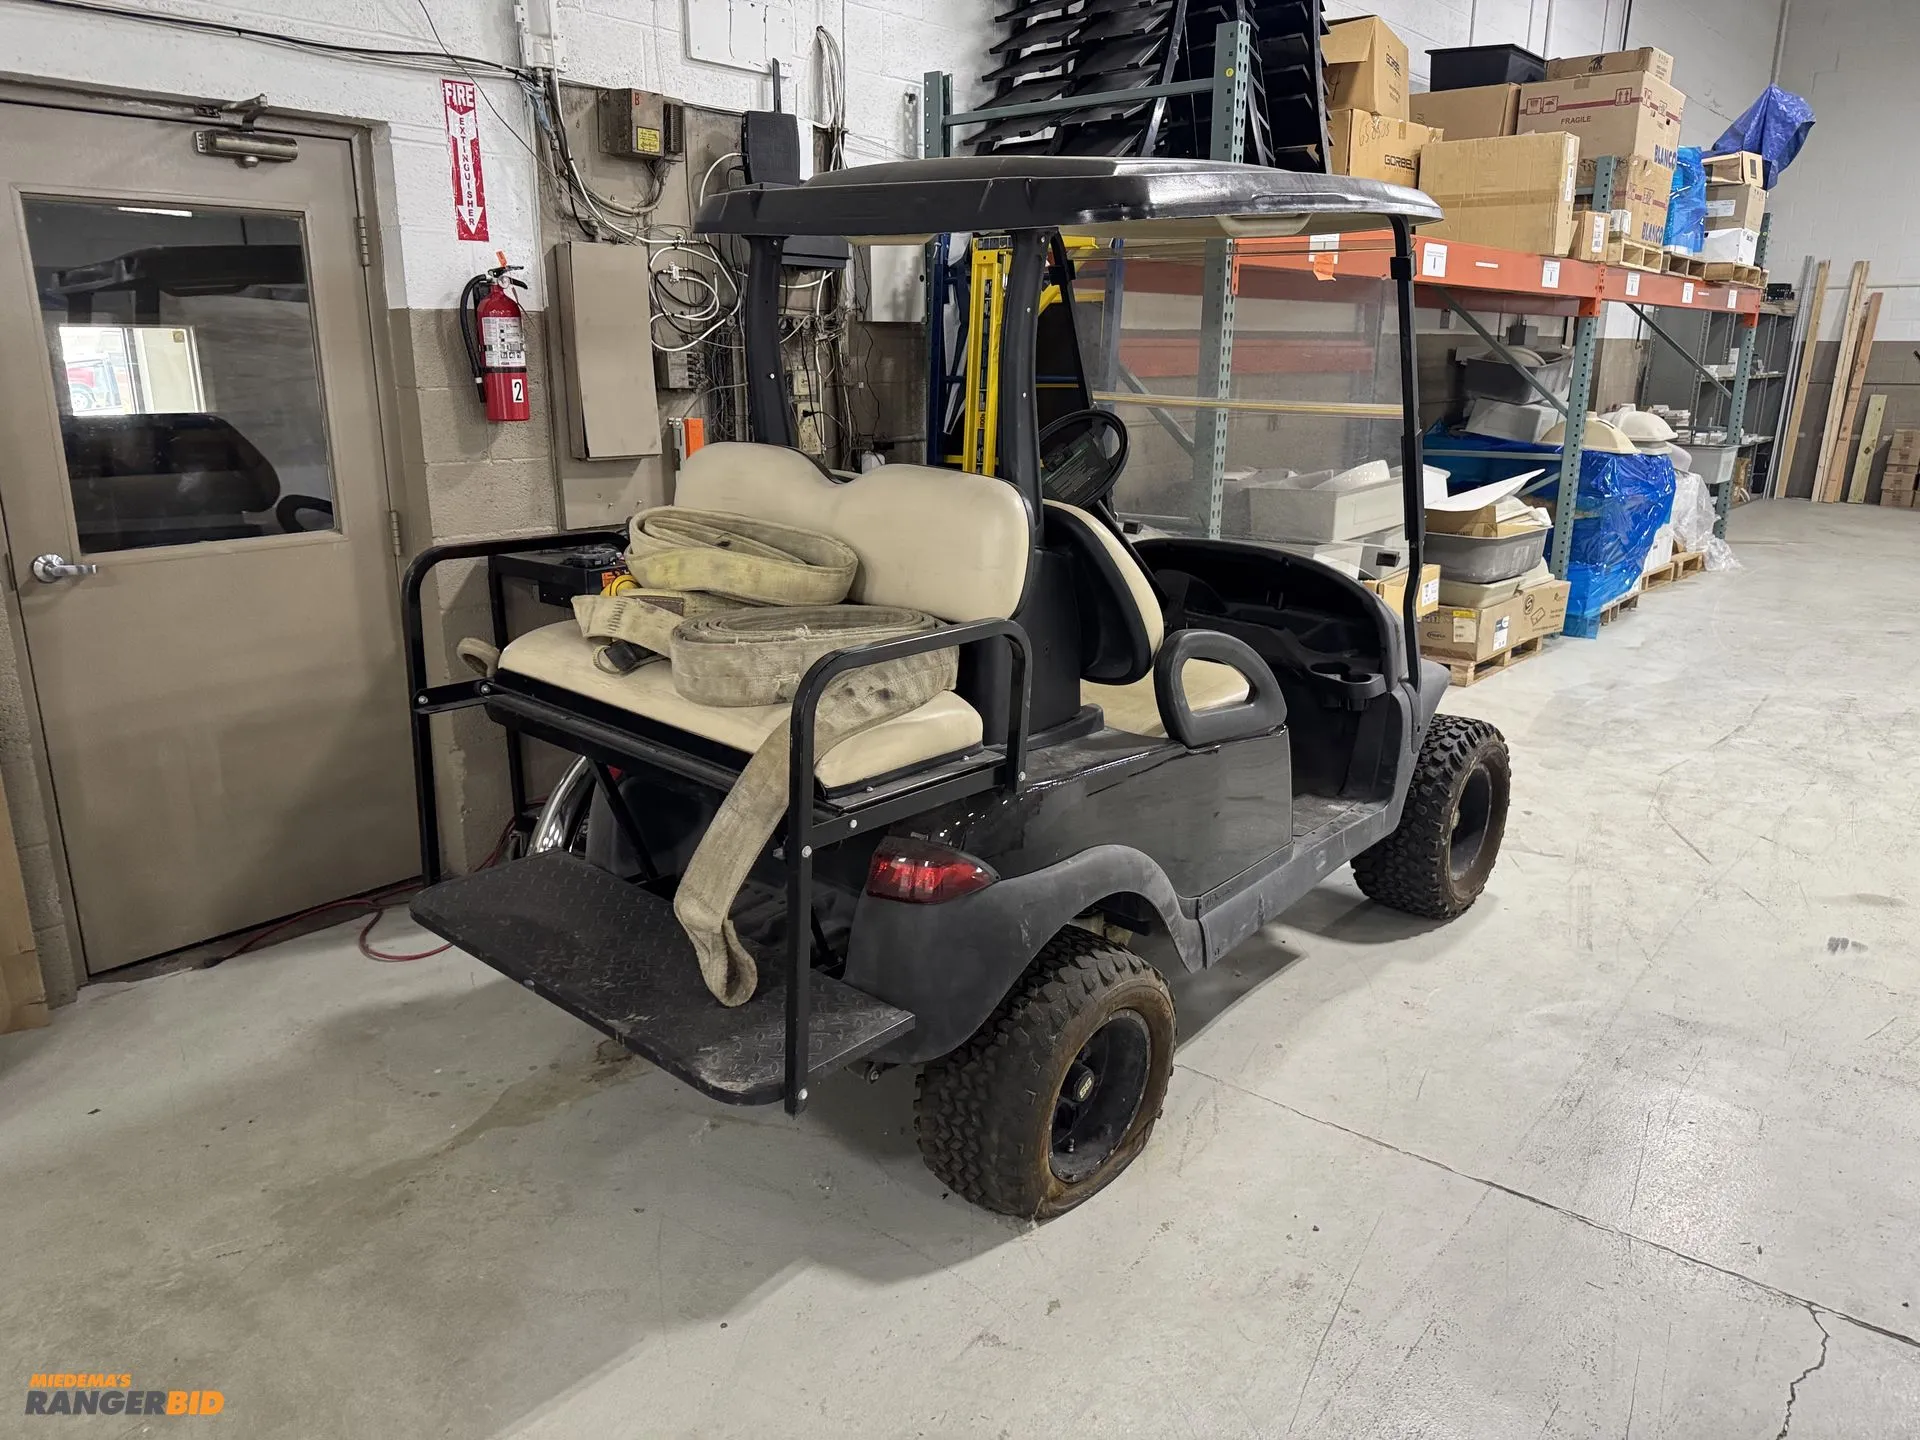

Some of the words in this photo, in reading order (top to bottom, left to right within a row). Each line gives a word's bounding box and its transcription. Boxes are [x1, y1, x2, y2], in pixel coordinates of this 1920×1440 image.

[444, 82, 475, 107] FIRE
[1560, 116, 1592, 125] FRAGILE
[1384, 154, 1415, 171] GORBEL
[1653, 144, 1677, 171] BLANCO
[459, 117, 475, 226] EXTINGUISHER
[1641, 221, 1664, 245] BLANCO
[514, 381, 522, 402] 2
